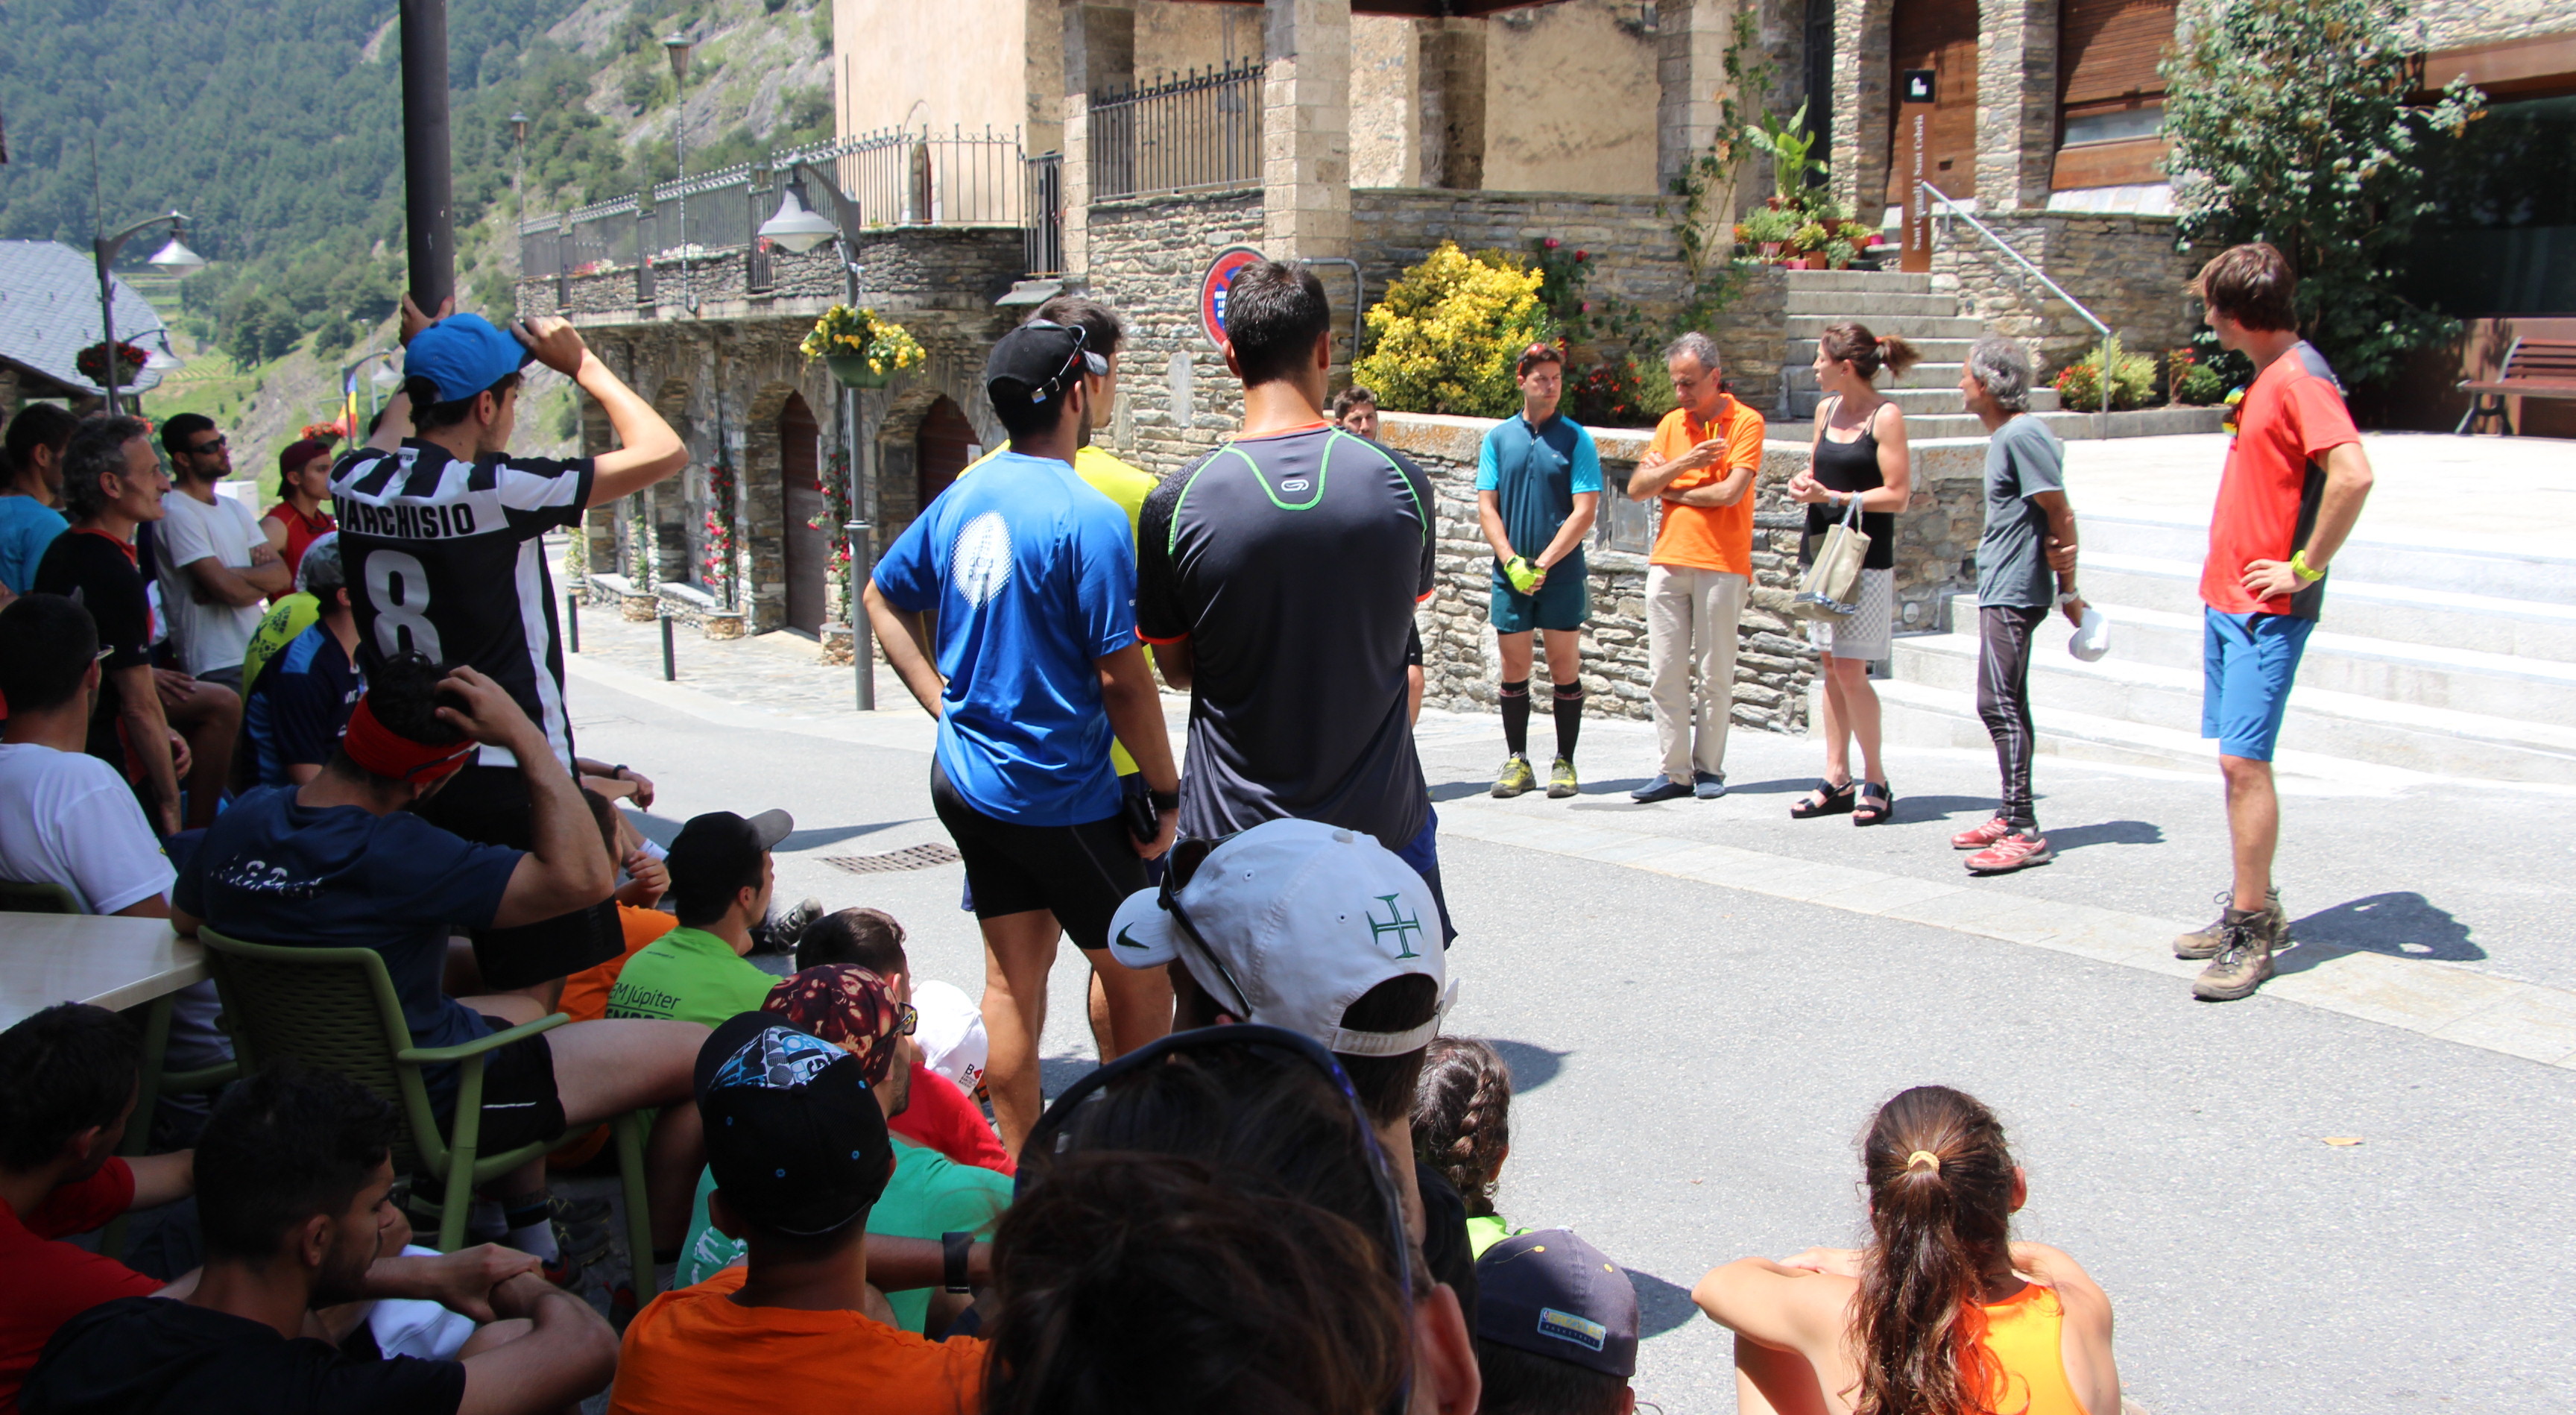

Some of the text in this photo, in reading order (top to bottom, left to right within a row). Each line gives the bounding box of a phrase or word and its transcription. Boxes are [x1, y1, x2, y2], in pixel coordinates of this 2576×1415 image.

[1913, 152, 1923, 176] Sant
[1912, 227, 1922, 250] Sant
[364, 549, 443, 666] 8
[624, 985, 682, 1010] Júpiter
